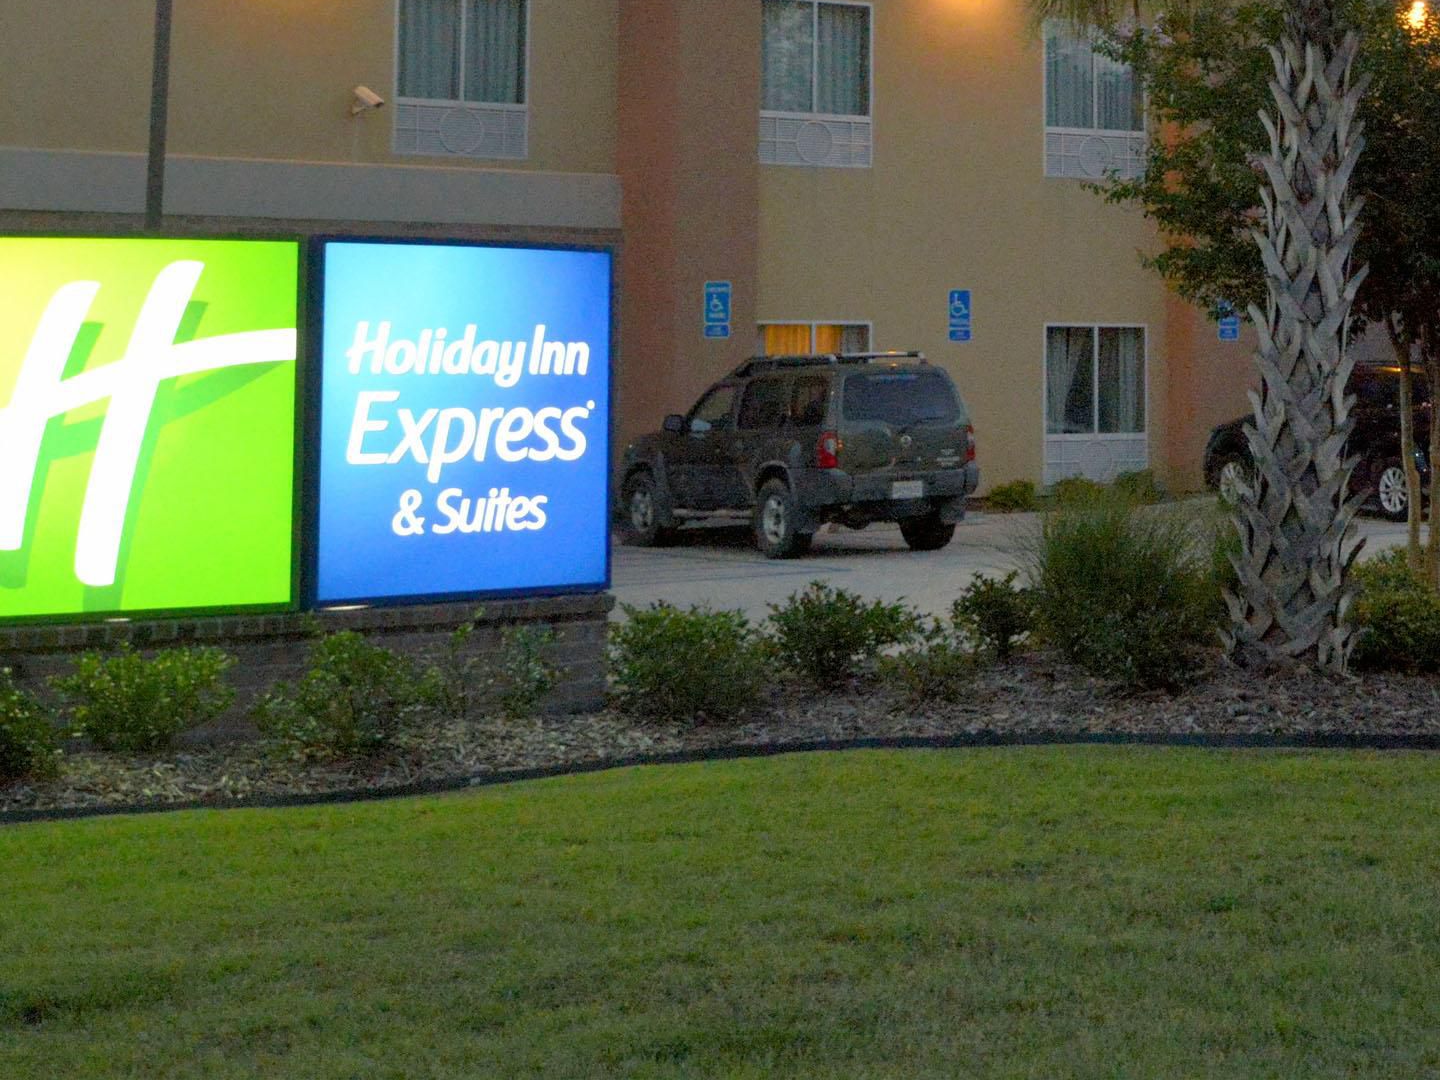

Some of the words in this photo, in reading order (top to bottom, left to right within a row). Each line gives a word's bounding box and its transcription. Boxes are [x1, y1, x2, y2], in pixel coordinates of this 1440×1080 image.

[346, 321, 526, 387] Holiday
[528, 324, 590, 375] Inn
[0, 260, 297, 586] H
[346, 391, 589, 483] Express
[392, 489, 425, 536] &
[432, 487, 548, 534] Suites
